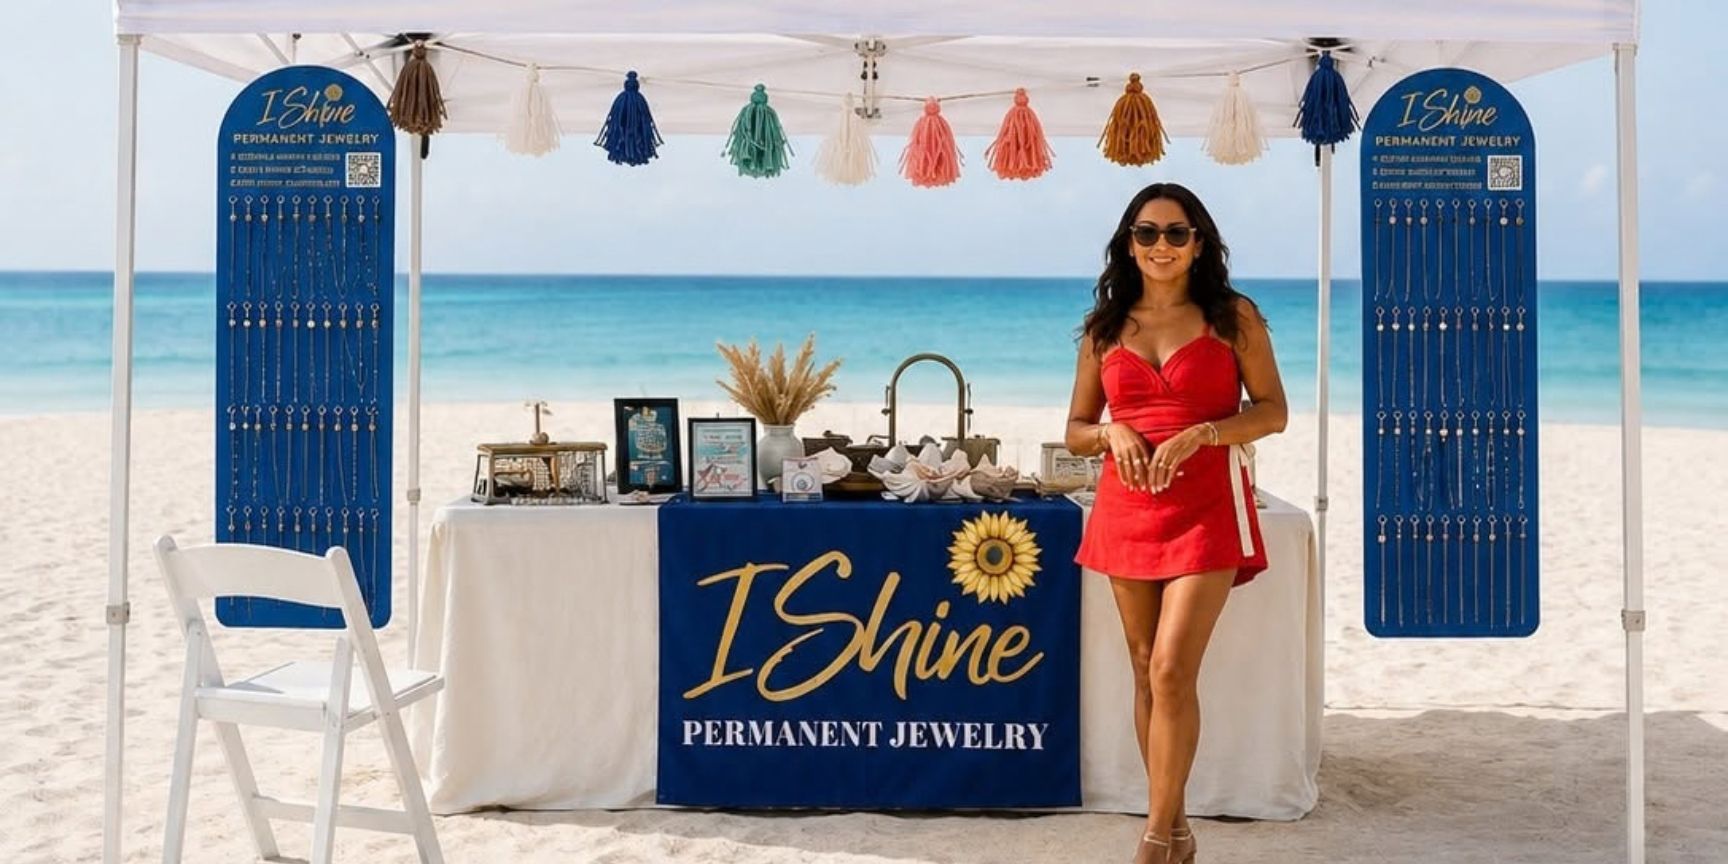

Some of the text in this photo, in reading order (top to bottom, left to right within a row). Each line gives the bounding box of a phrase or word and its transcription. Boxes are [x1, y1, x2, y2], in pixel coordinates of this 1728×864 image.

[256, 89, 283, 126] I
[1397, 92, 1423, 128] I
[1461, 136, 1521, 146] JEWELRY
[682, 550, 1045, 702] I Shine
[682, 720, 1049, 750] PERMANENT JEWELRY
